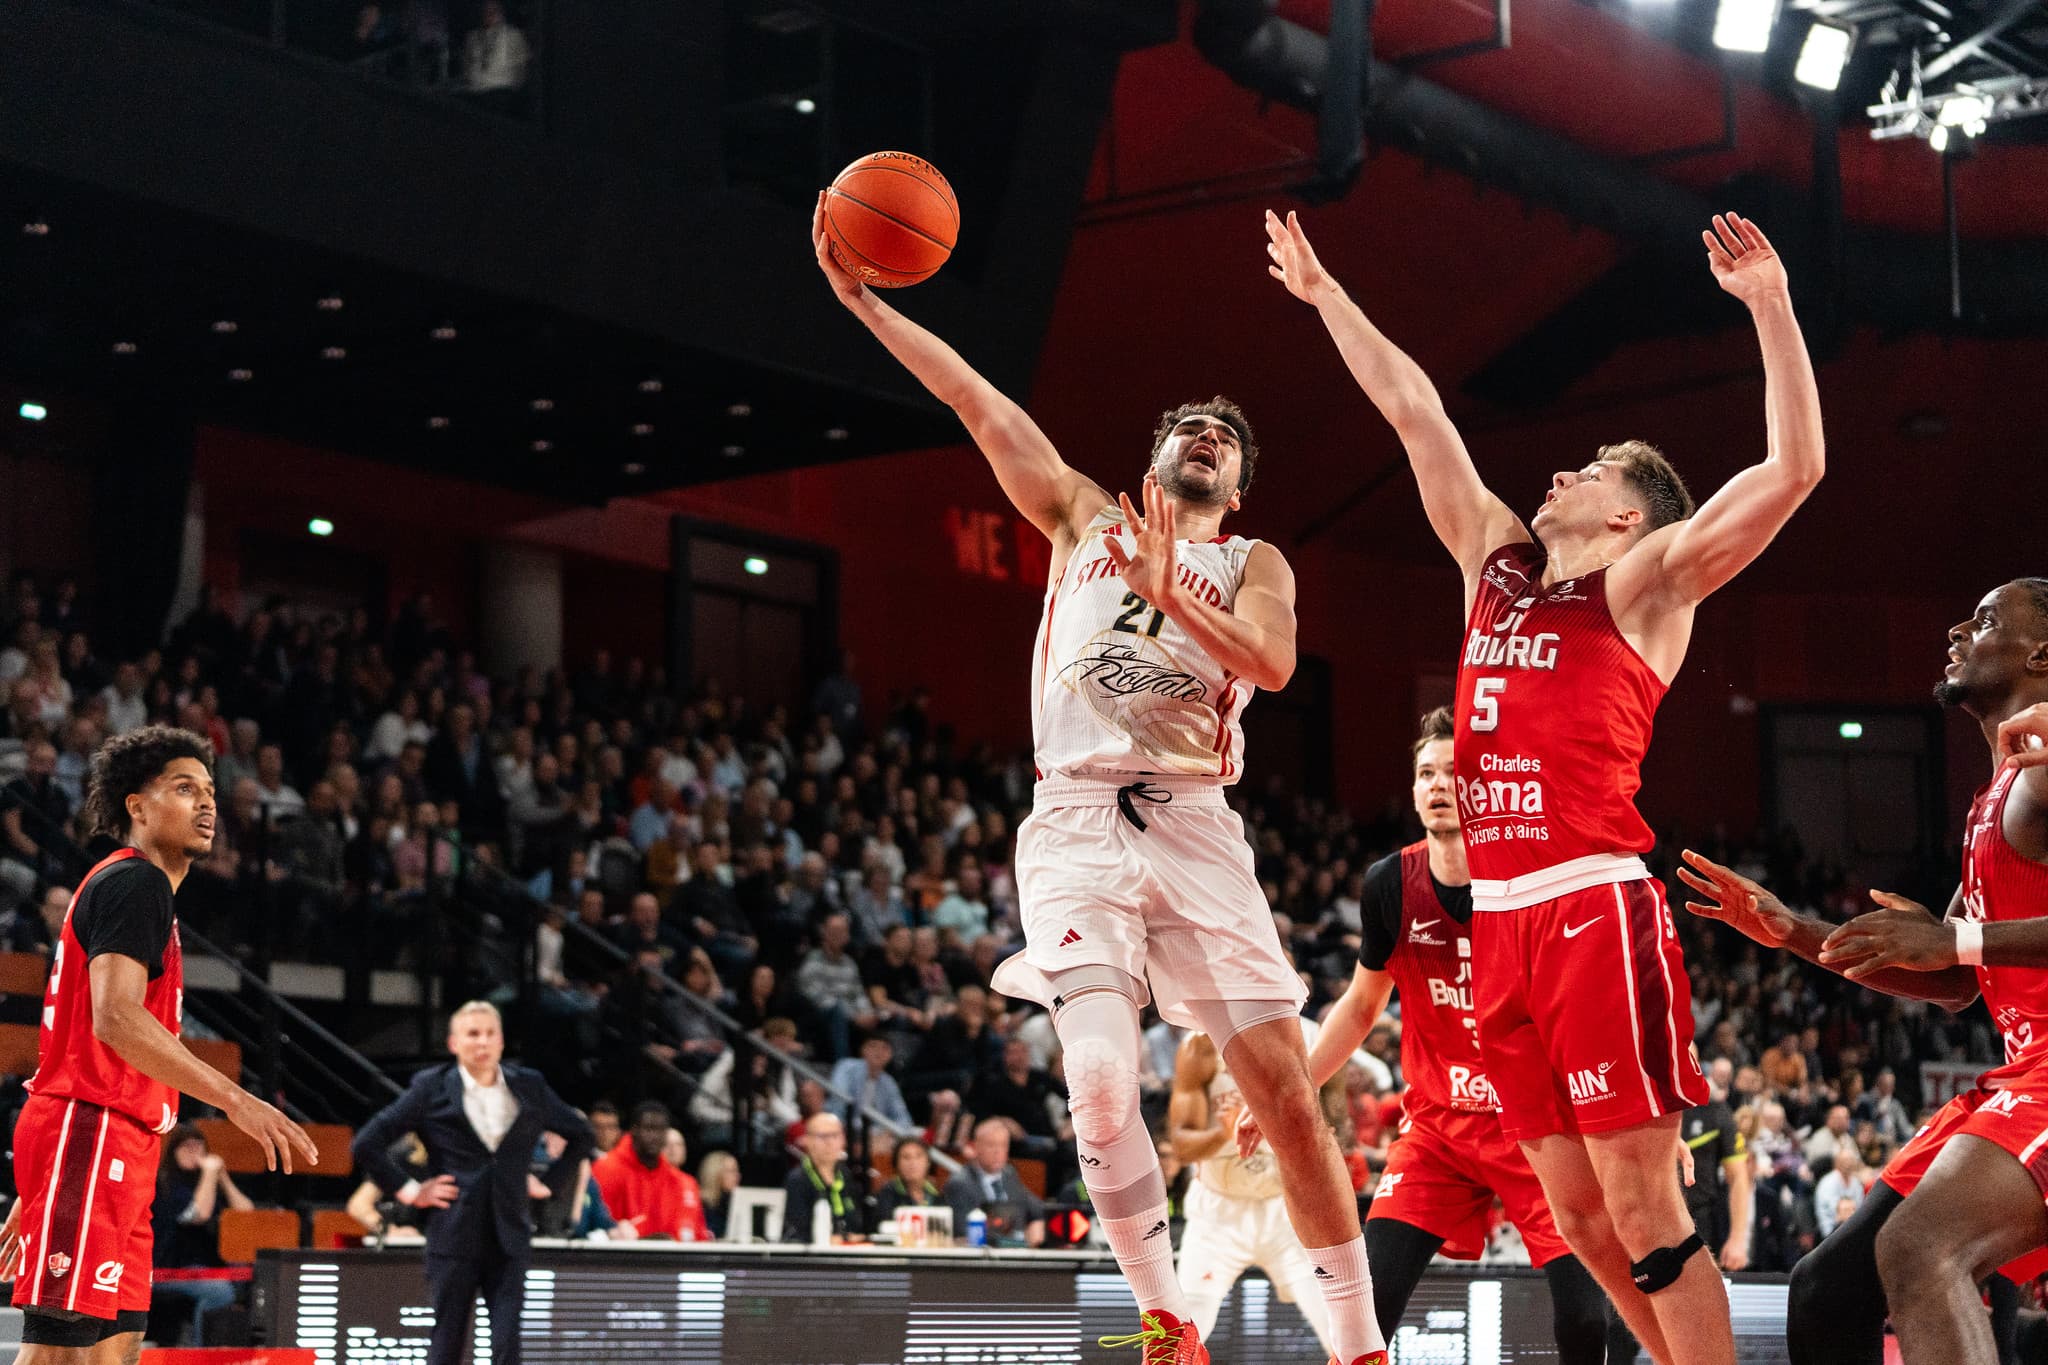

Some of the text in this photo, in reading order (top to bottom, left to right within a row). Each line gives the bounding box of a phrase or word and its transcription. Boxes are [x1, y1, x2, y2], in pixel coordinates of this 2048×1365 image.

[1113, 590, 1165, 638] 21
[1052, 657, 1208, 704] Royale
[1470, 677, 1507, 733] 5
[1480, 753, 1541, 772] Charles
[1510, 821, 1550, 841] ains
[1428, 978, 1474, 1011] BOU
[1567, 1069, 1609, 1100] AIN
